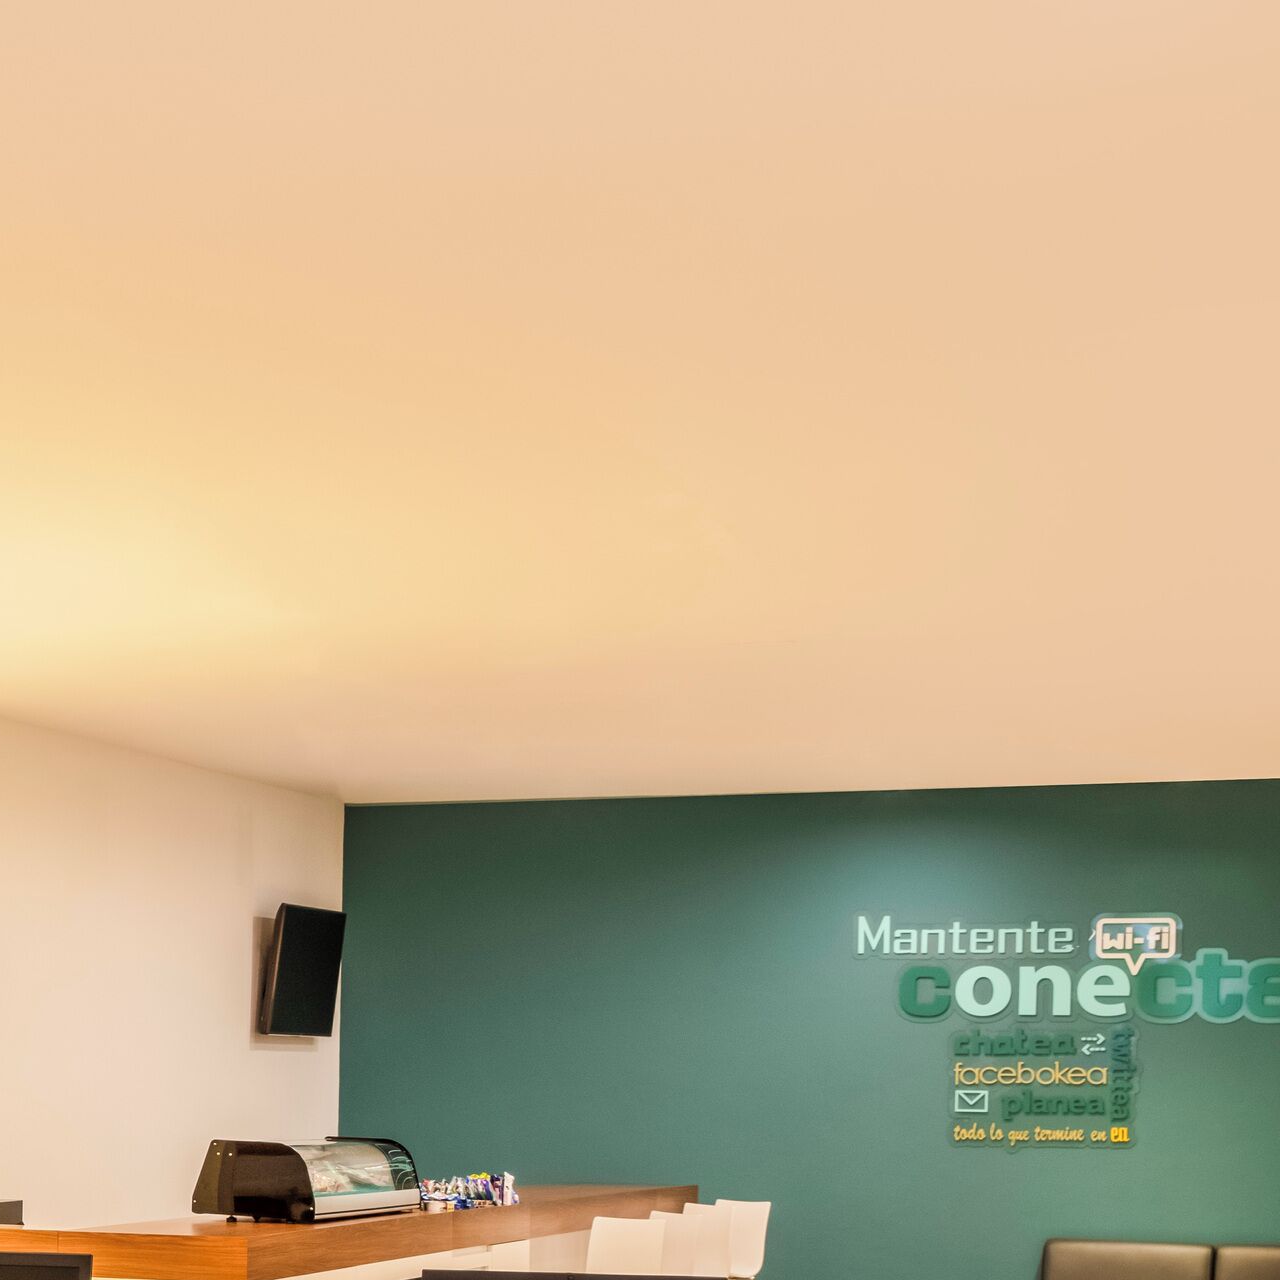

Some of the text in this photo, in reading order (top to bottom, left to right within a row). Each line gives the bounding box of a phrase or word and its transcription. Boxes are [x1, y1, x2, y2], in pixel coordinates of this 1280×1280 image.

[856, 914, 1074, 955] Mantente
[1101, 926, 1170, 951] wi-fi
[953, 1029, 1077, 1057] chatea
[953, 1061, 1109, 1085] facebokea
[1001, 1090, 1107, 1123] planea
[953, 1122, 986, 1142] todo
[989, 1122, 1004, 1142] lo
[1007, 1129, 1030, 1146] que
[1033, 1126, 1085, 1142] termine
[1090, 1130, 1108, 1142] en
